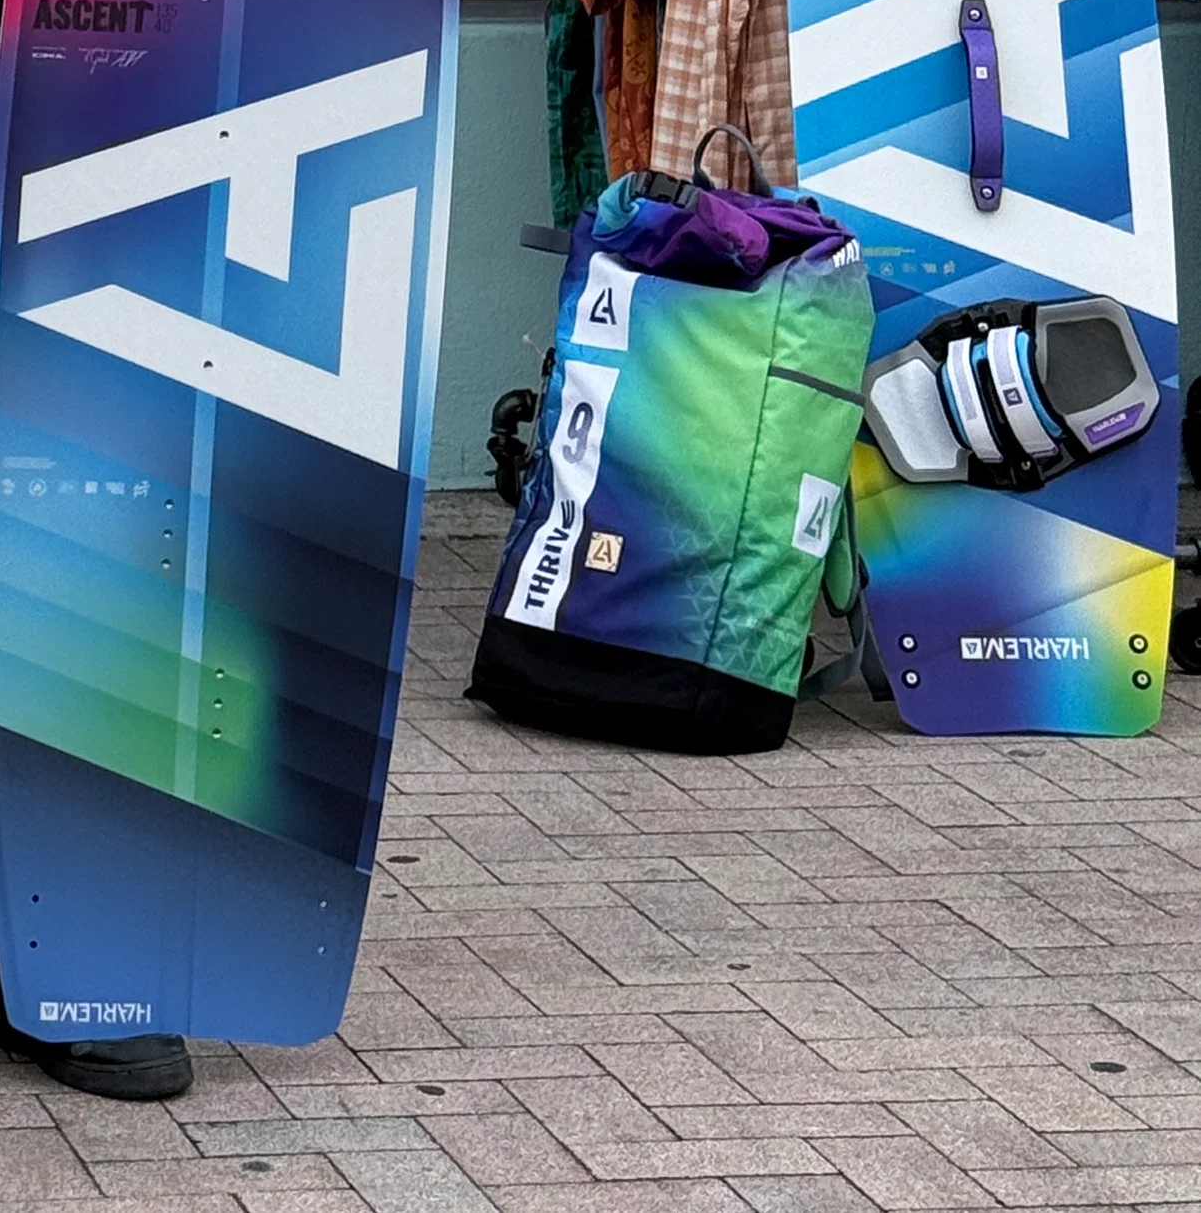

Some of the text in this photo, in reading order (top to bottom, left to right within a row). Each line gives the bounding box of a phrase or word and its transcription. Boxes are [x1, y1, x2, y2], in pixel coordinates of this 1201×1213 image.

[562, 401, 594, 465] 9
[524, 499, 576, 610] THRIVE
[983, 637, 1090, 660] HARLEM
[59, 1001, 152, 1024] HARLEM
